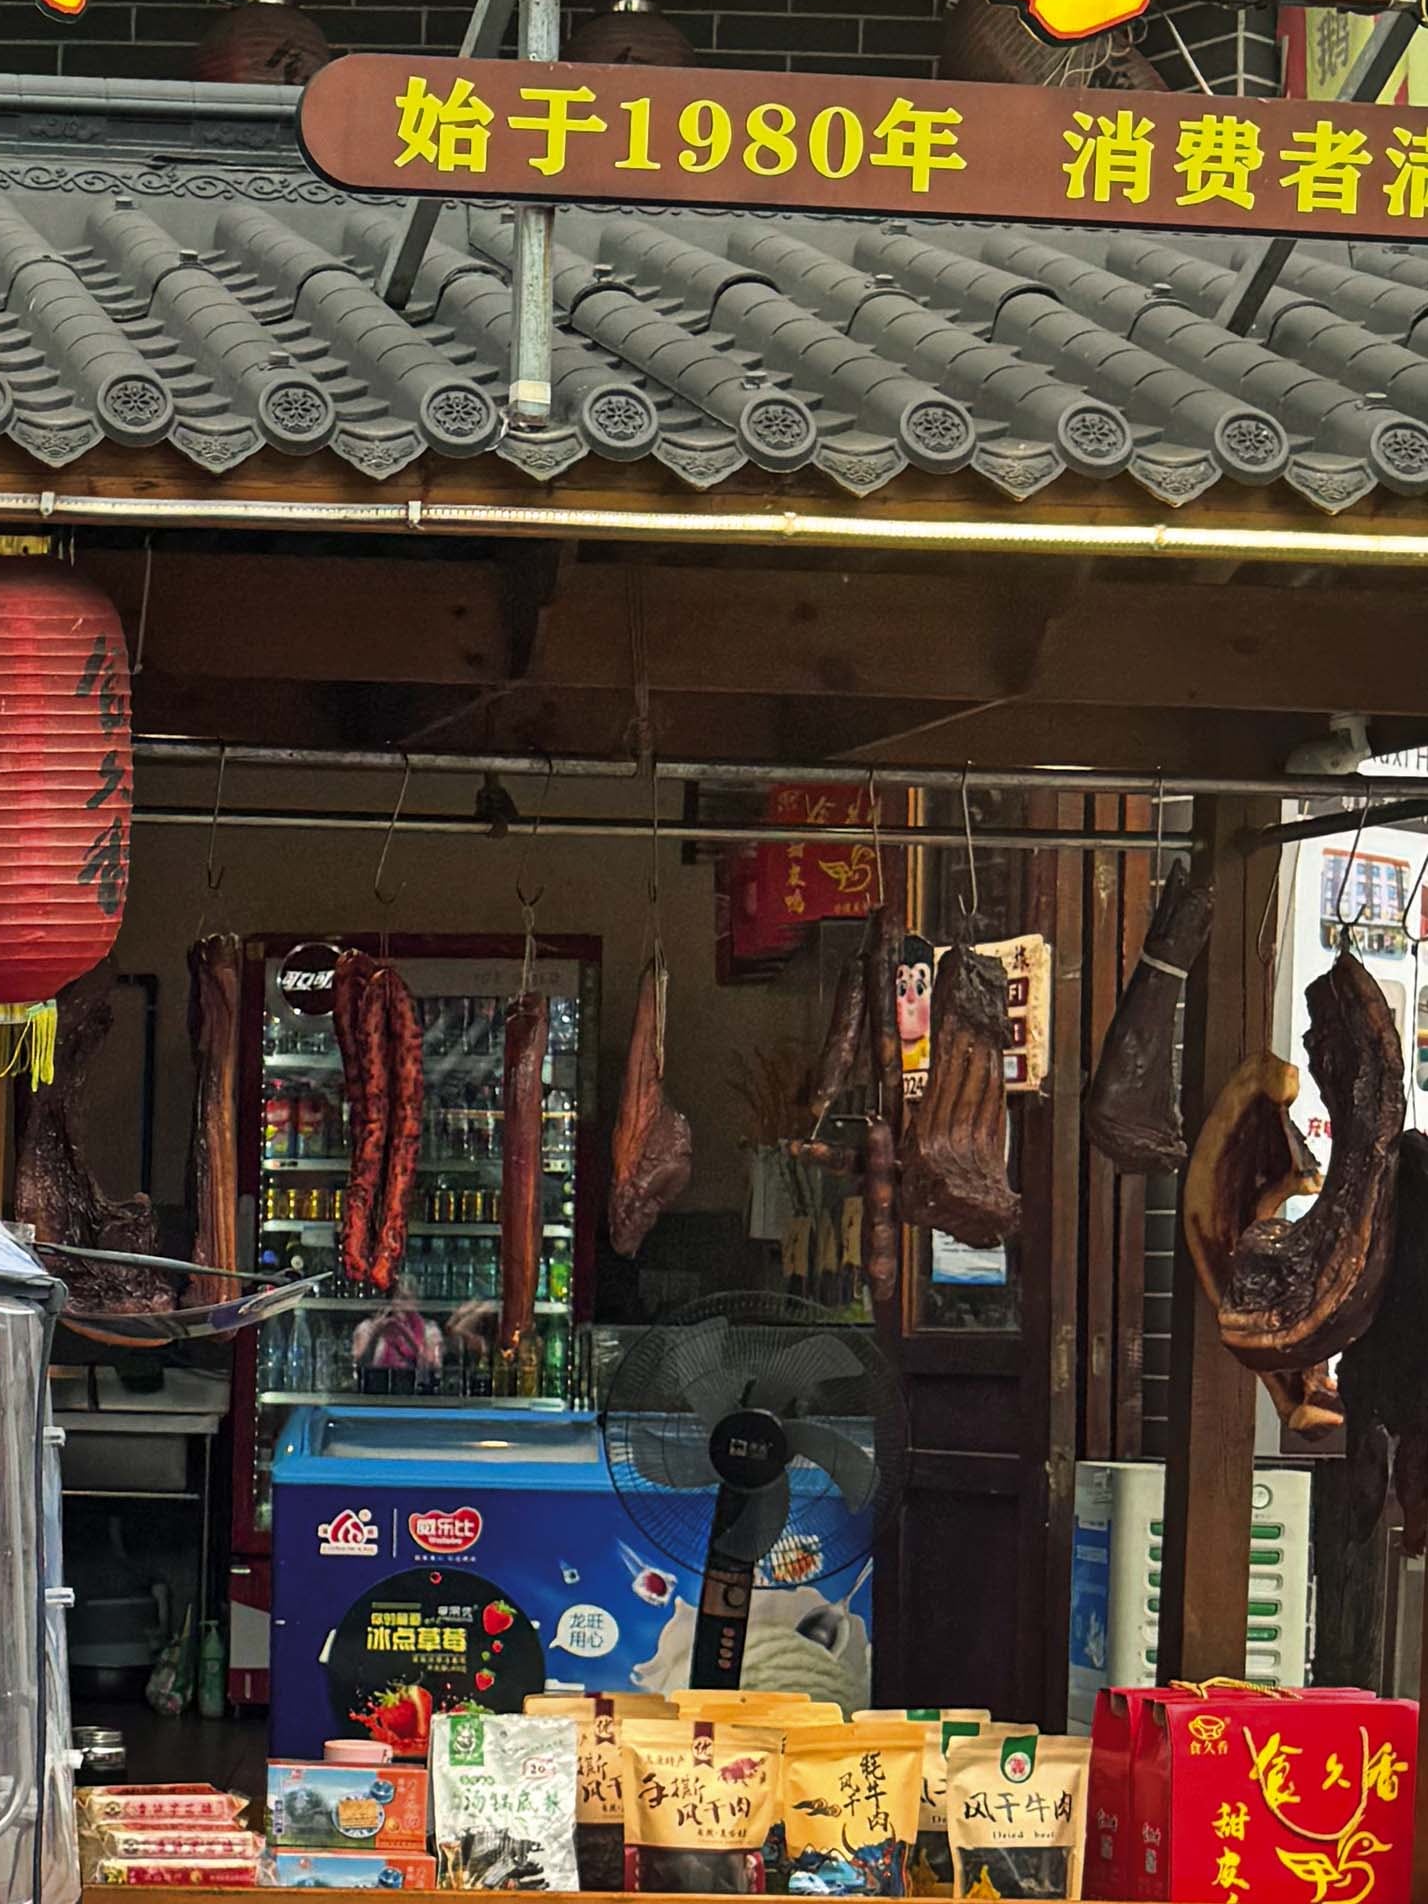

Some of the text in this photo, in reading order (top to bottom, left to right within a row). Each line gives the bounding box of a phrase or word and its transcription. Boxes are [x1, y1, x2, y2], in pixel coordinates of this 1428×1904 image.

[394, 76, 967, 193] 始于1980年
[963, 1790, 1074, 1824] 风干牛肉
[1212, 1802, 1250, 1904] 甜皮
